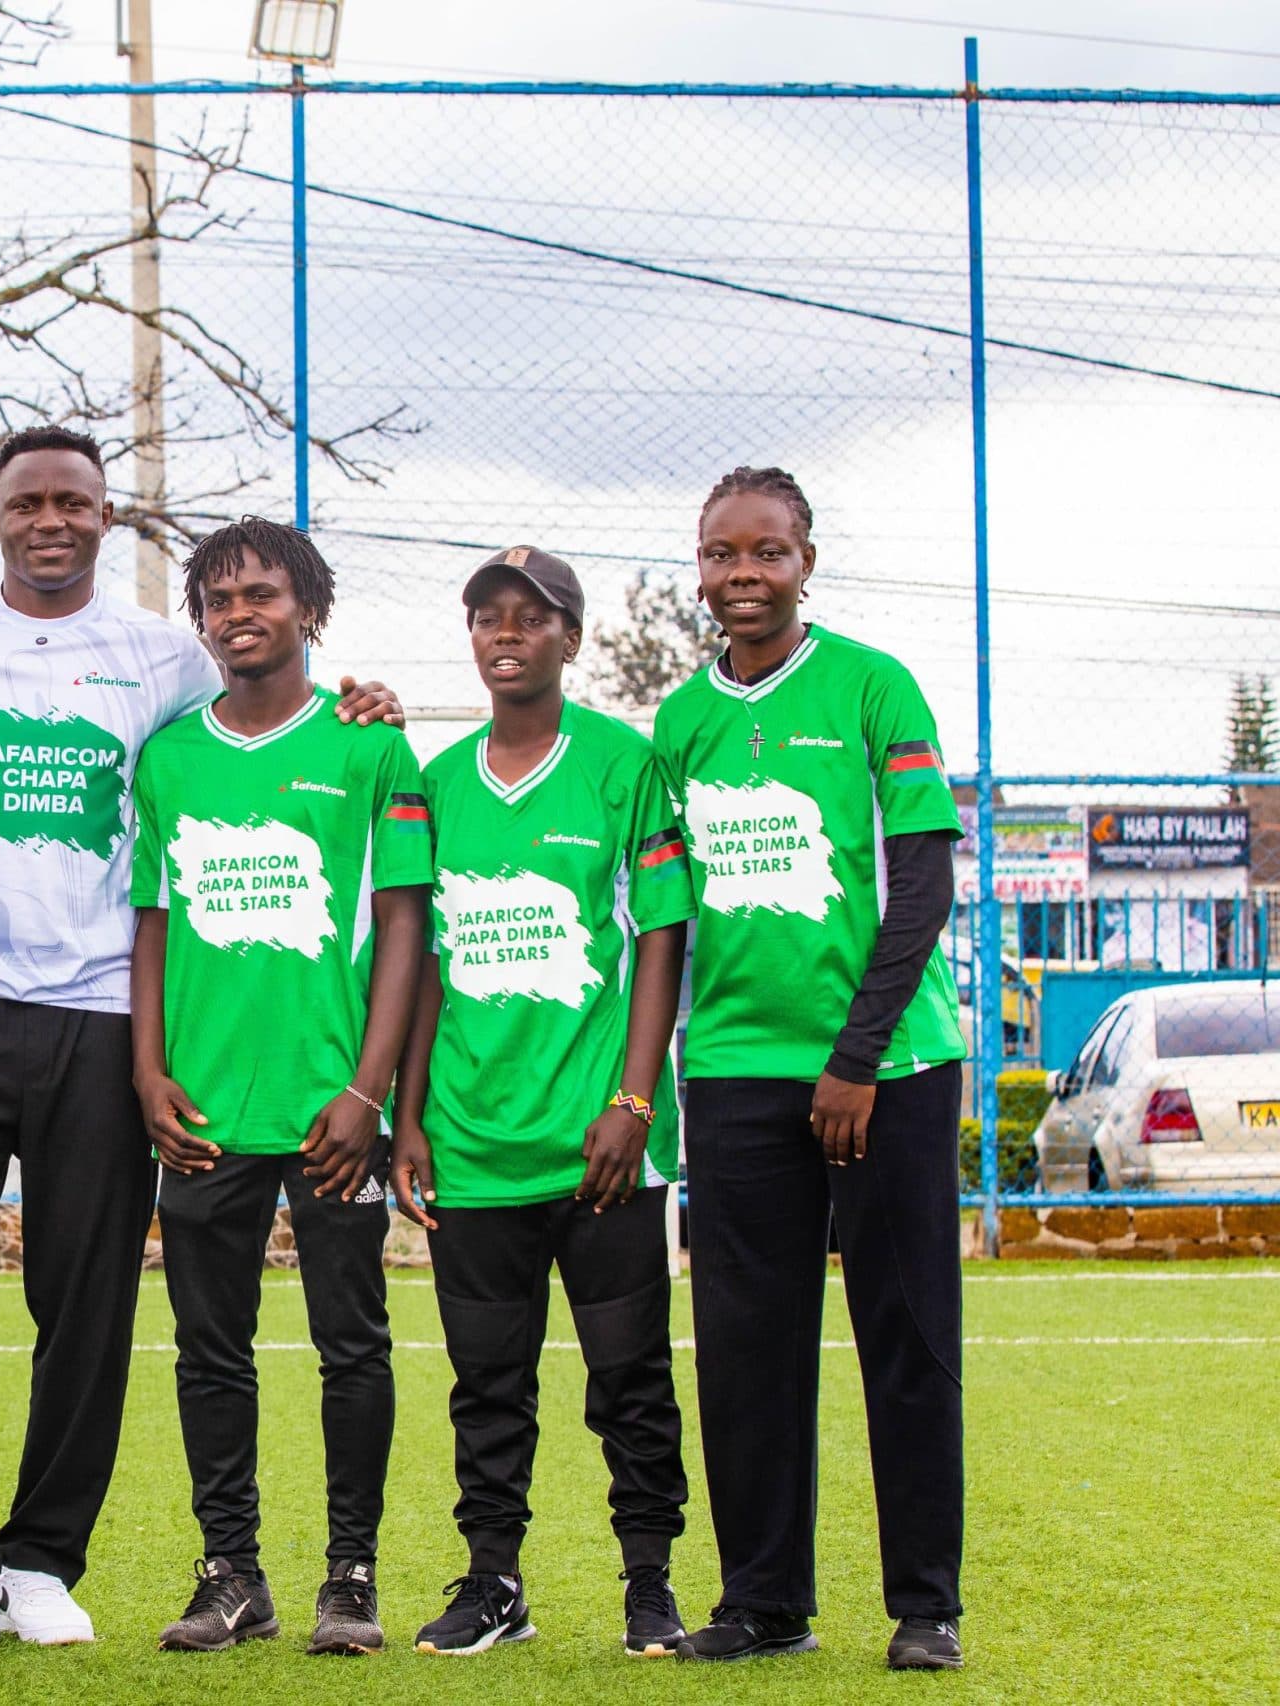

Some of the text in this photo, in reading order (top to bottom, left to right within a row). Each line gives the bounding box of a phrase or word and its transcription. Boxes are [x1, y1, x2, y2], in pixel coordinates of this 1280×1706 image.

[85, 675, 141, 688] Safaricom
[789, 736, 843, 748] Safaricom
[3, 768, 87, 789] CHAPA
[291, 781, 347, 797] Safaricom
[3, 793, 84, 814] DIMBA
[1123, 815, 1160, 841] HAIR
[1162, 815, 1184, 841] BY
[543, 834, 600, 848] Safaricom
[753, 836, 810, 852] DIMBA
[202, 855, 299, 874] SAFARICOM
[708, 857, 792, 877] ALL STARS
[197, 875, 309, 894] CHAPA DIMBA
[962, 880, 1084, 899] CEMISTS
[206, 895, 292, 912] ALL STARS
[454, 925, 567, 947] HAPA DIMBA
[463, 946, 549, 966] ALL STARS
[355, 1191, 384, 1204] adidas
